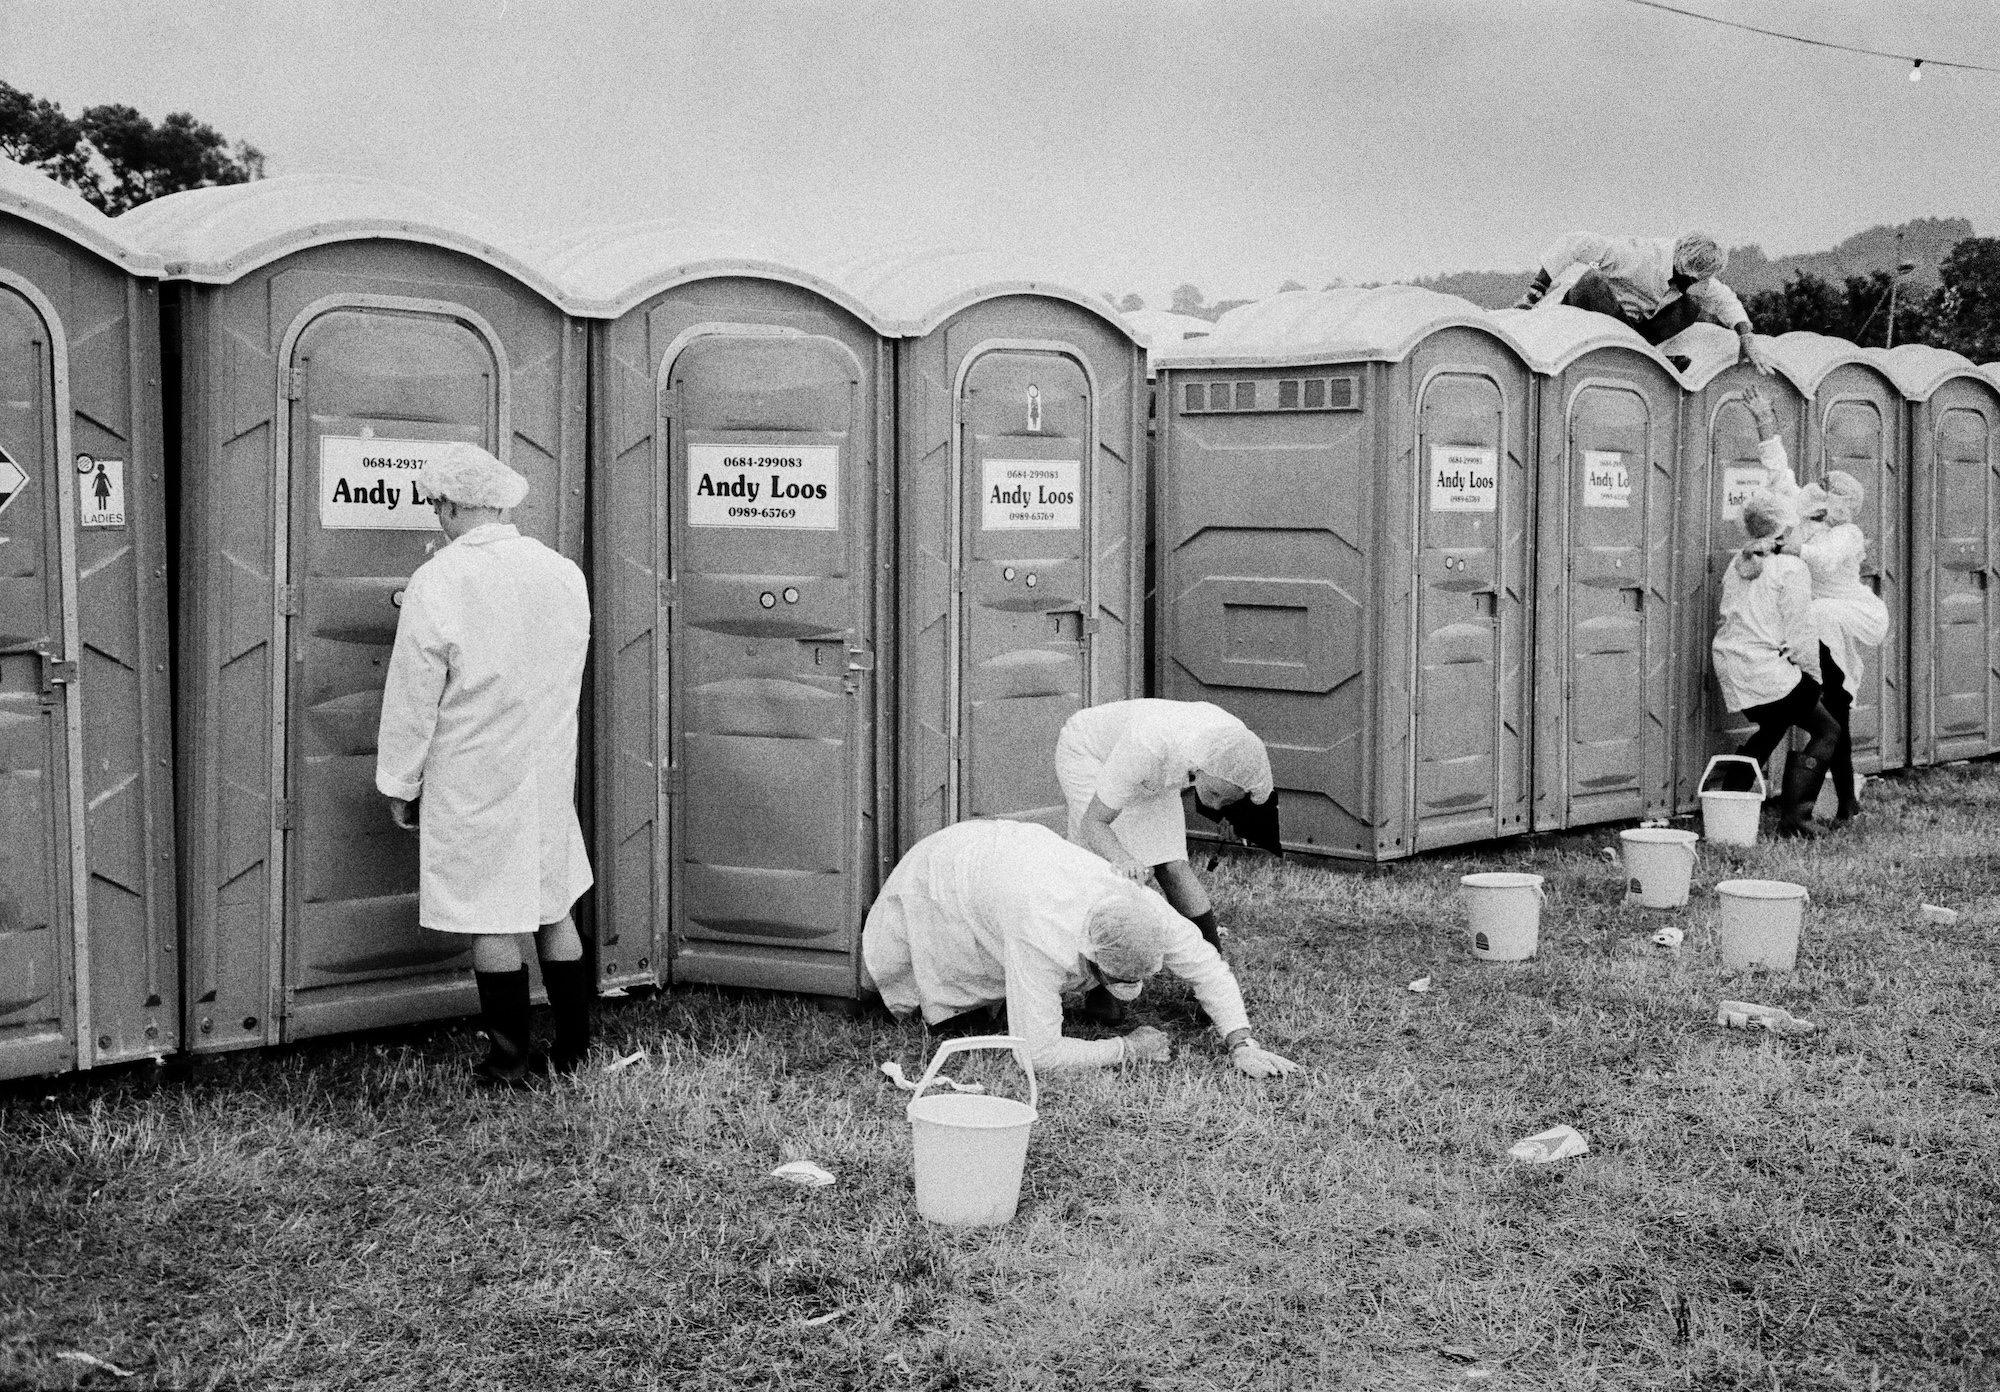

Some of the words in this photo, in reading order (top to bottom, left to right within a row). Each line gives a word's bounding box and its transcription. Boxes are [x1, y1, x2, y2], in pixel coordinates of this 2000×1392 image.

[363, 457, 428, 470] 0684-2937
[723, 457, 803, 468] 0684-299083
[1007, 470, 1059, 479] 0684-299083
[1437, 470, 1465, 492] Andy
[1469, 471, 1494, 489] Loos
[1588, 470, 1614, 491] Andy
[332, 477, 401, 511] Andy
[697, 473, 760, 503] Andy
[771, 475, 827, 500] Loos
[990, 484, 1031, 509] Andy
[1038, 485, 1074, 504] Loos
[83, 513, 124, 524] LADIES
[728, 507, 796, 519] 0989-65769
[1009, 512, 1055, 521] 0989-65769
